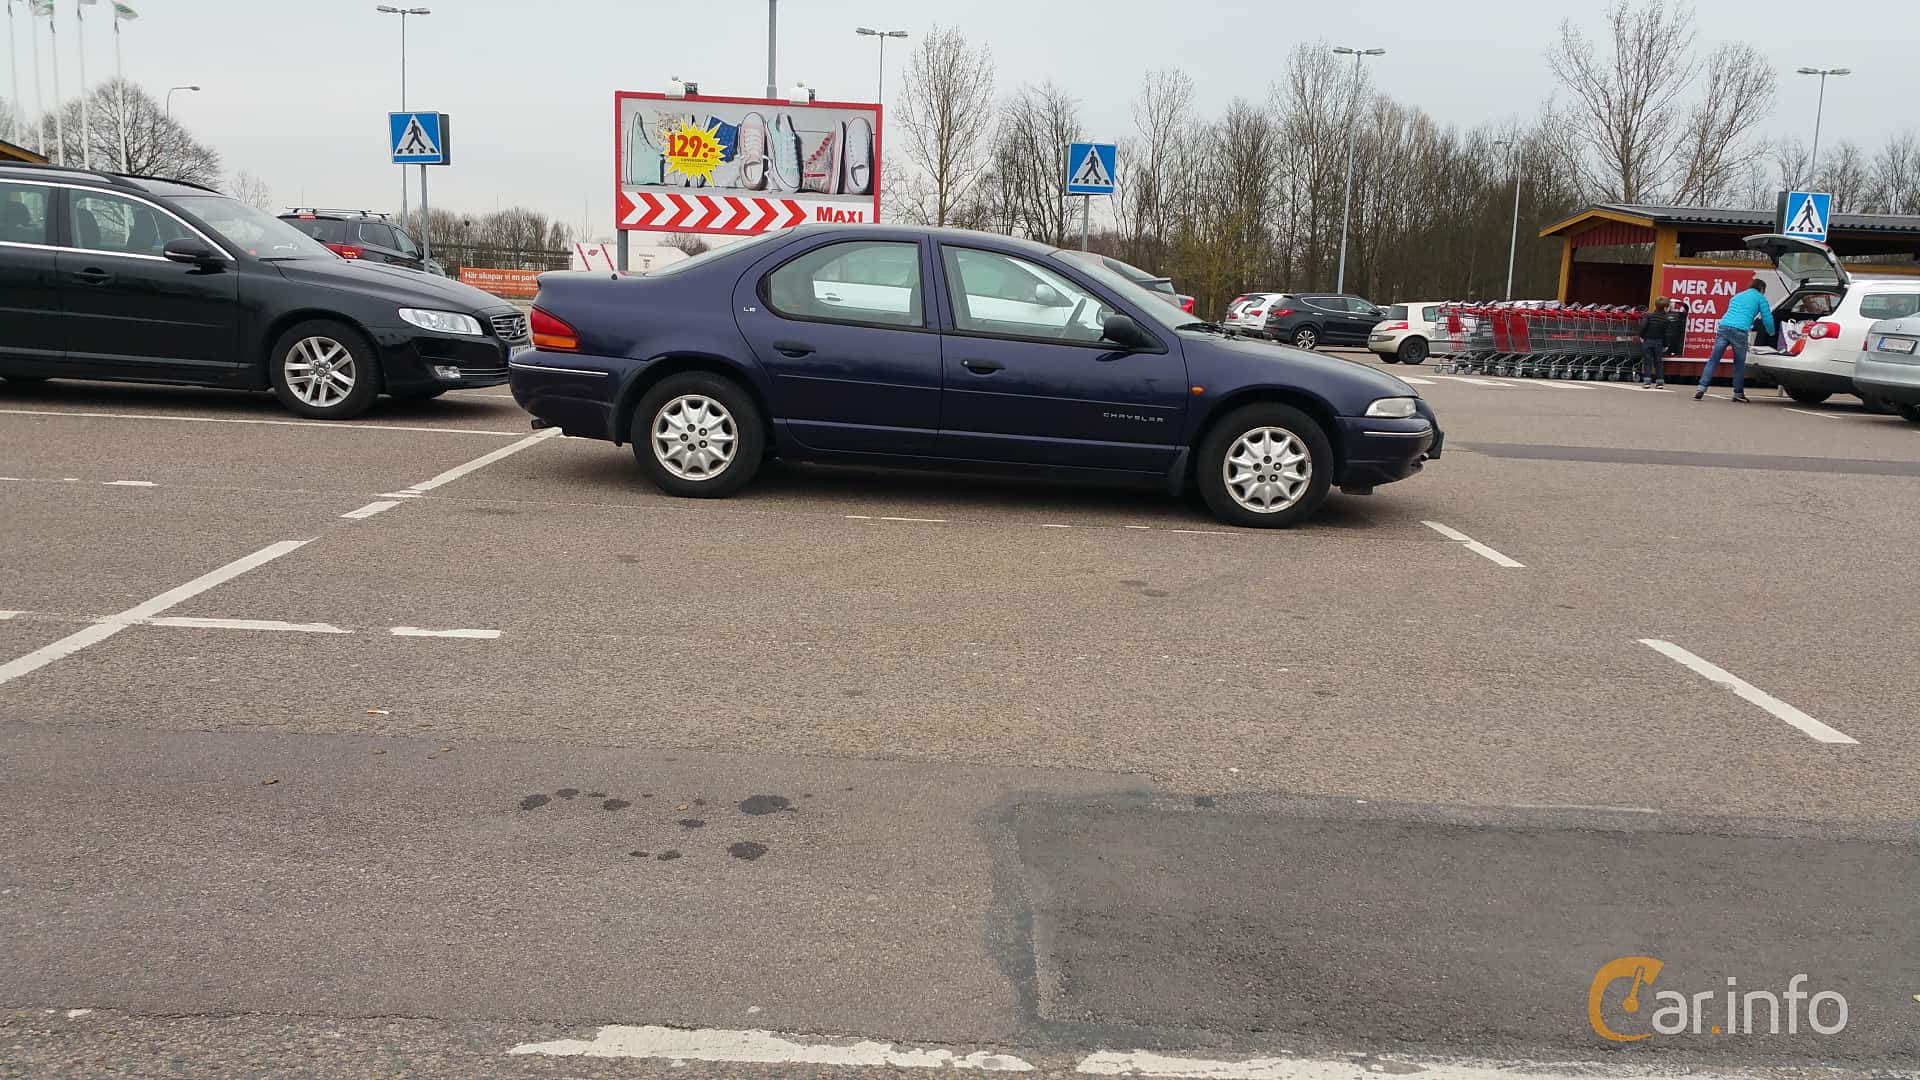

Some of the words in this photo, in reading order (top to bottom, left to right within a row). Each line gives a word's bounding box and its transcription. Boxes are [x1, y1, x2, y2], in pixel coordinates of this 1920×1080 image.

[669, 134, 716, 158] 129:-
[816, 206, 863, 224] MAXI
[1672, 280, 1708, 295] MER
[1711, 278, 1737, 296] ÄN
